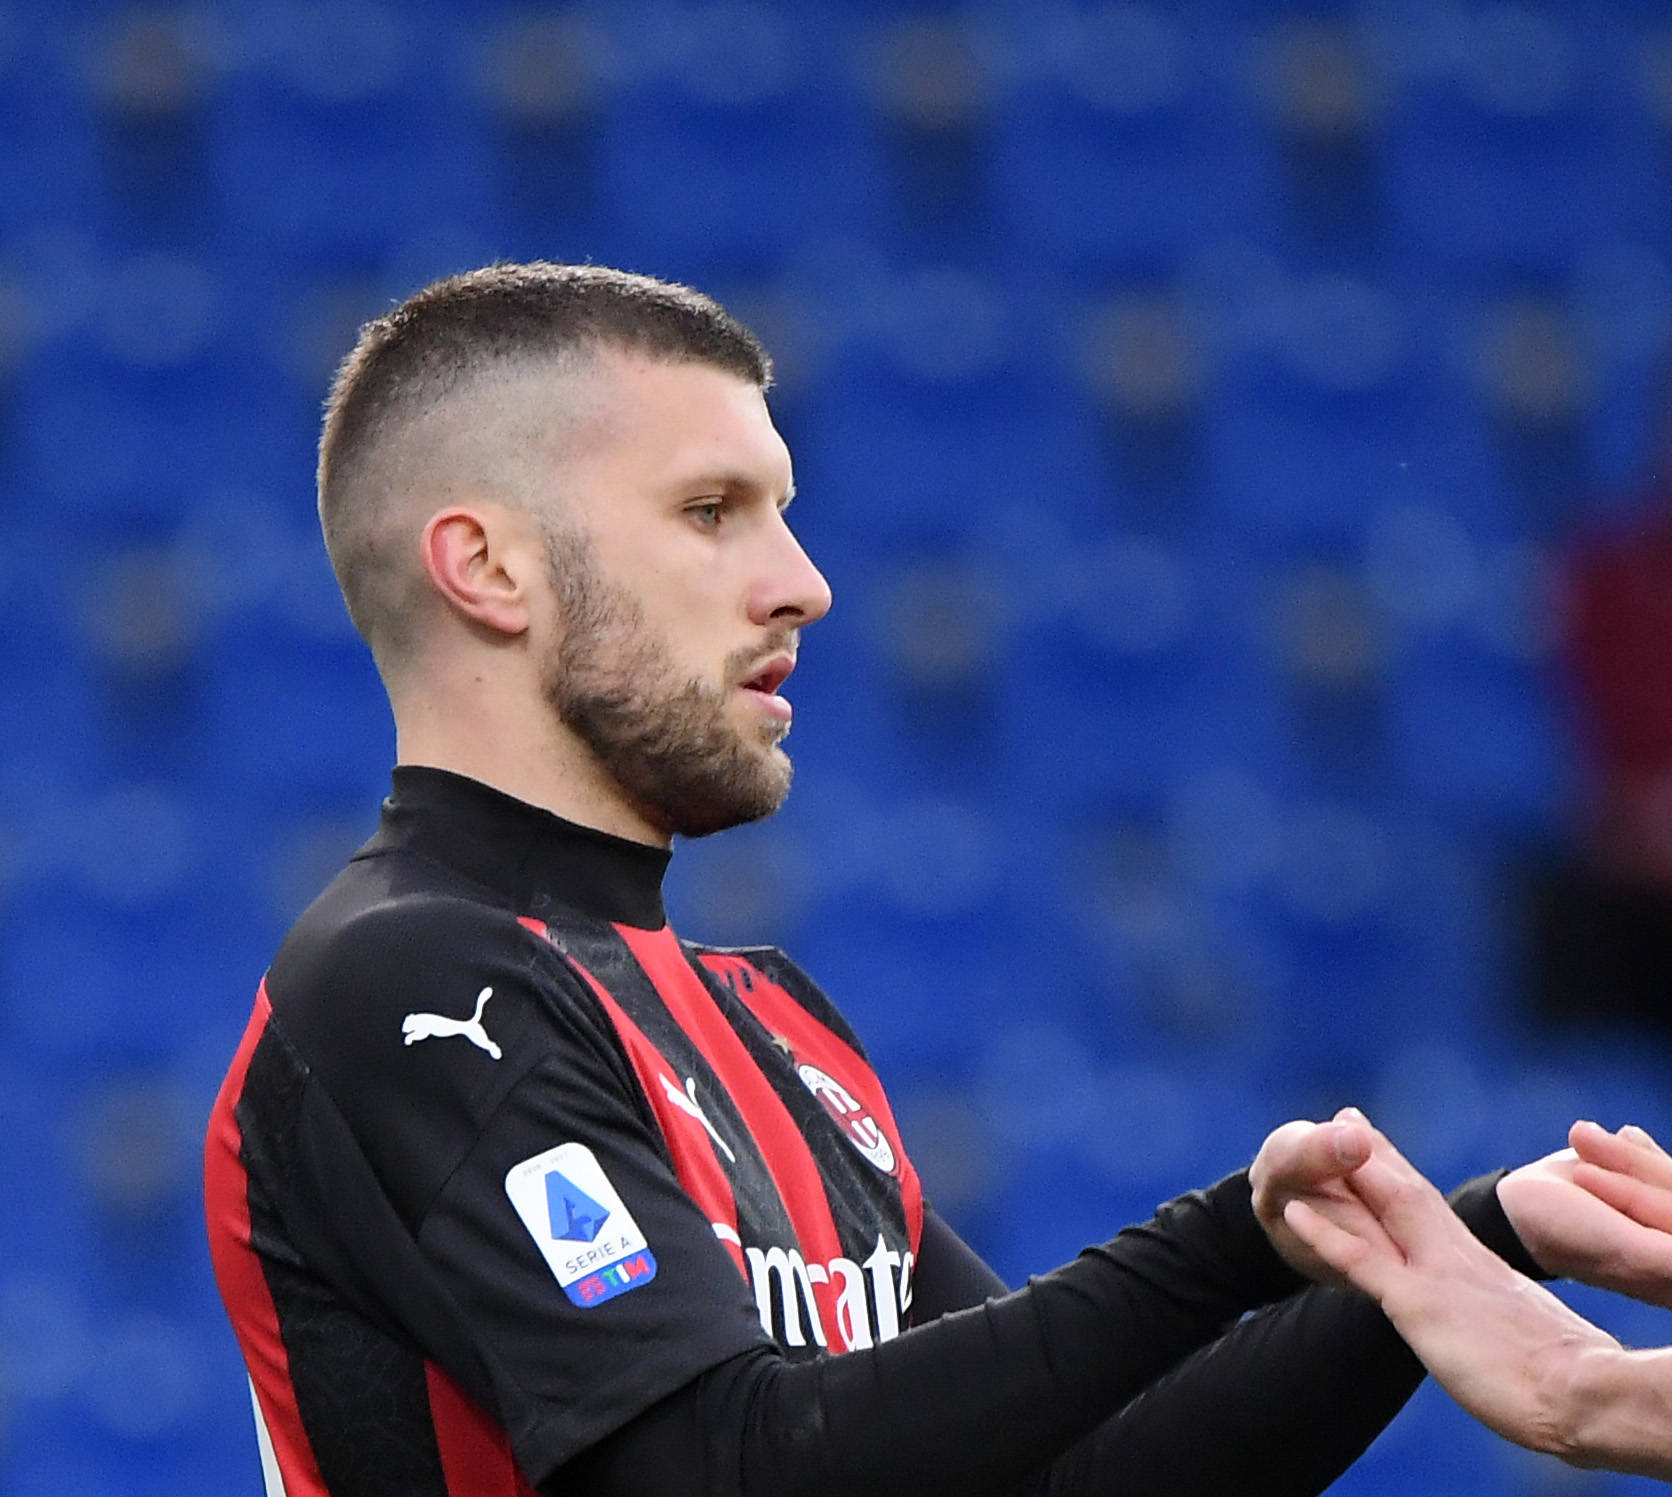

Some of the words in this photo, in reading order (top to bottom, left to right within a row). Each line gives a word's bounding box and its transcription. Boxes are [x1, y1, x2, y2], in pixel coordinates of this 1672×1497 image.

[566, 1242, 616, 1275] SERIE
[620, 1236, 631, 1249] A
[602, 1255, 650, 1287] TIM
